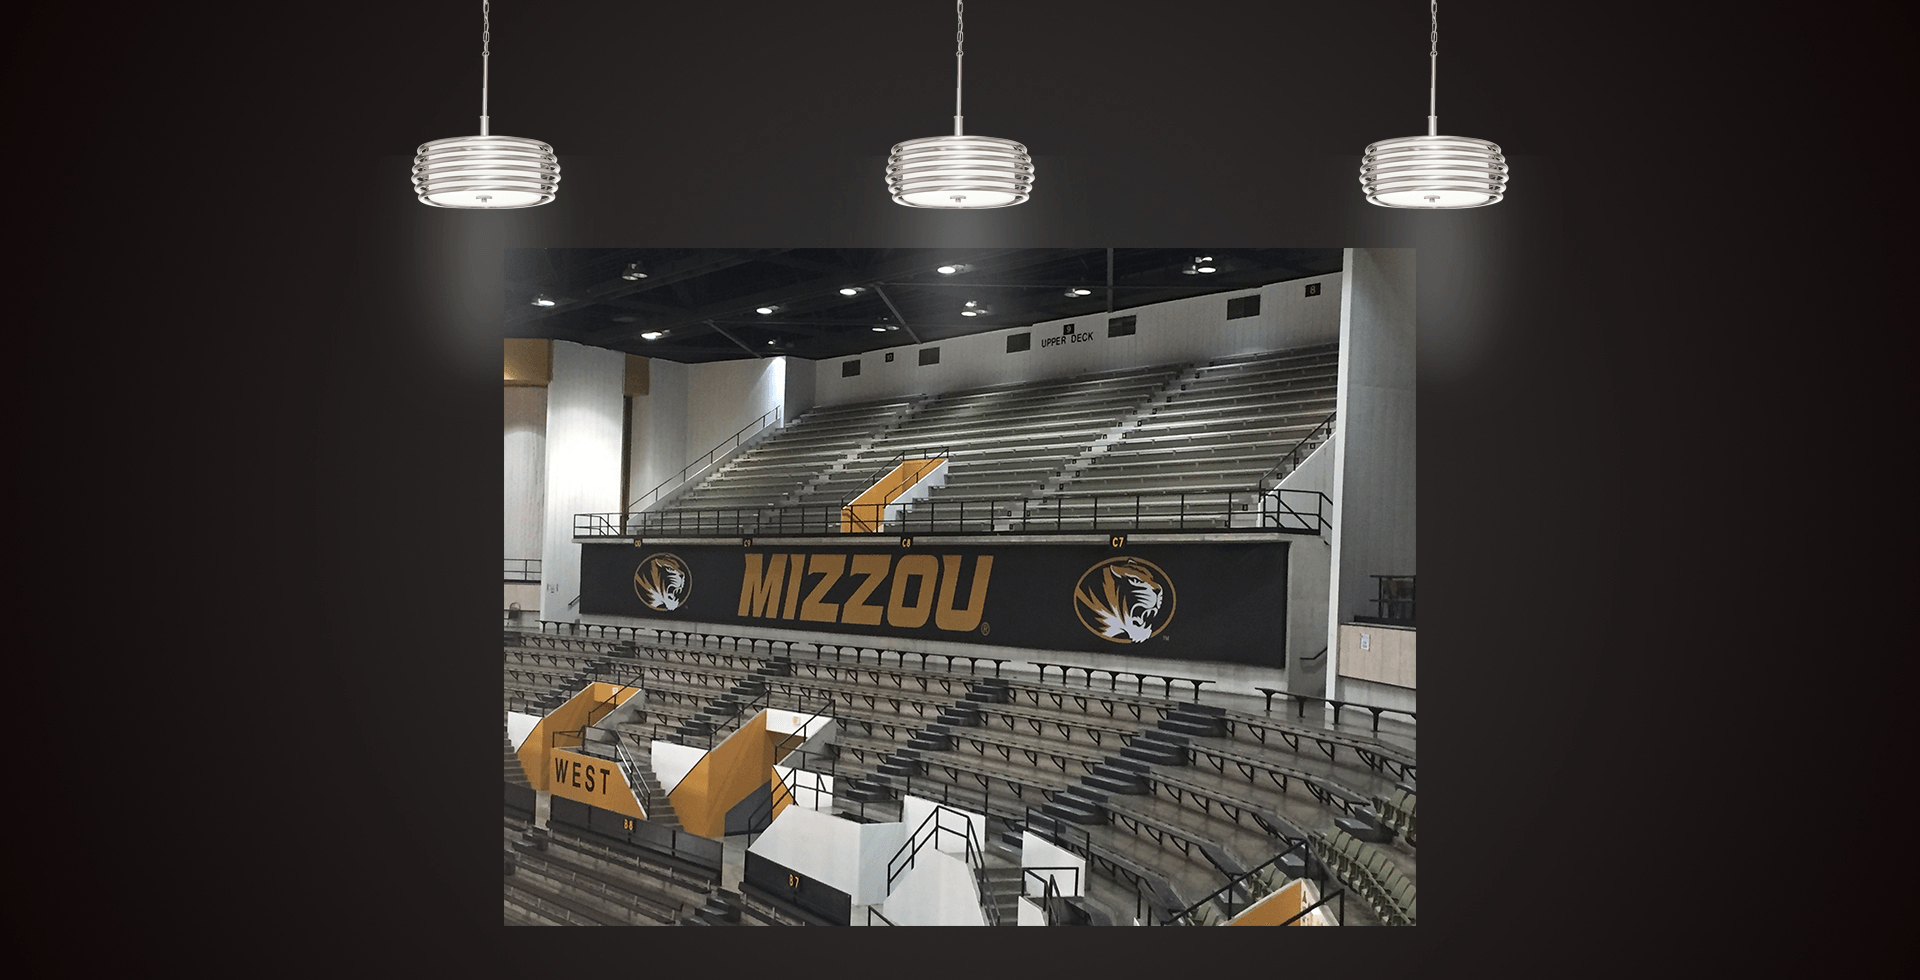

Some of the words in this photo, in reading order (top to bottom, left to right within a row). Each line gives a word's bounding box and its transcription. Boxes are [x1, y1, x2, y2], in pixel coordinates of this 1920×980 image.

[1041, 336, 1066, 348] UPPER
[1071, 332, 1094, 343] DECK
[1112, 536, 1124, 548] C7
[737, 553, 994, 632] MIZZOU
[555, 757, 610, 795] WEST
